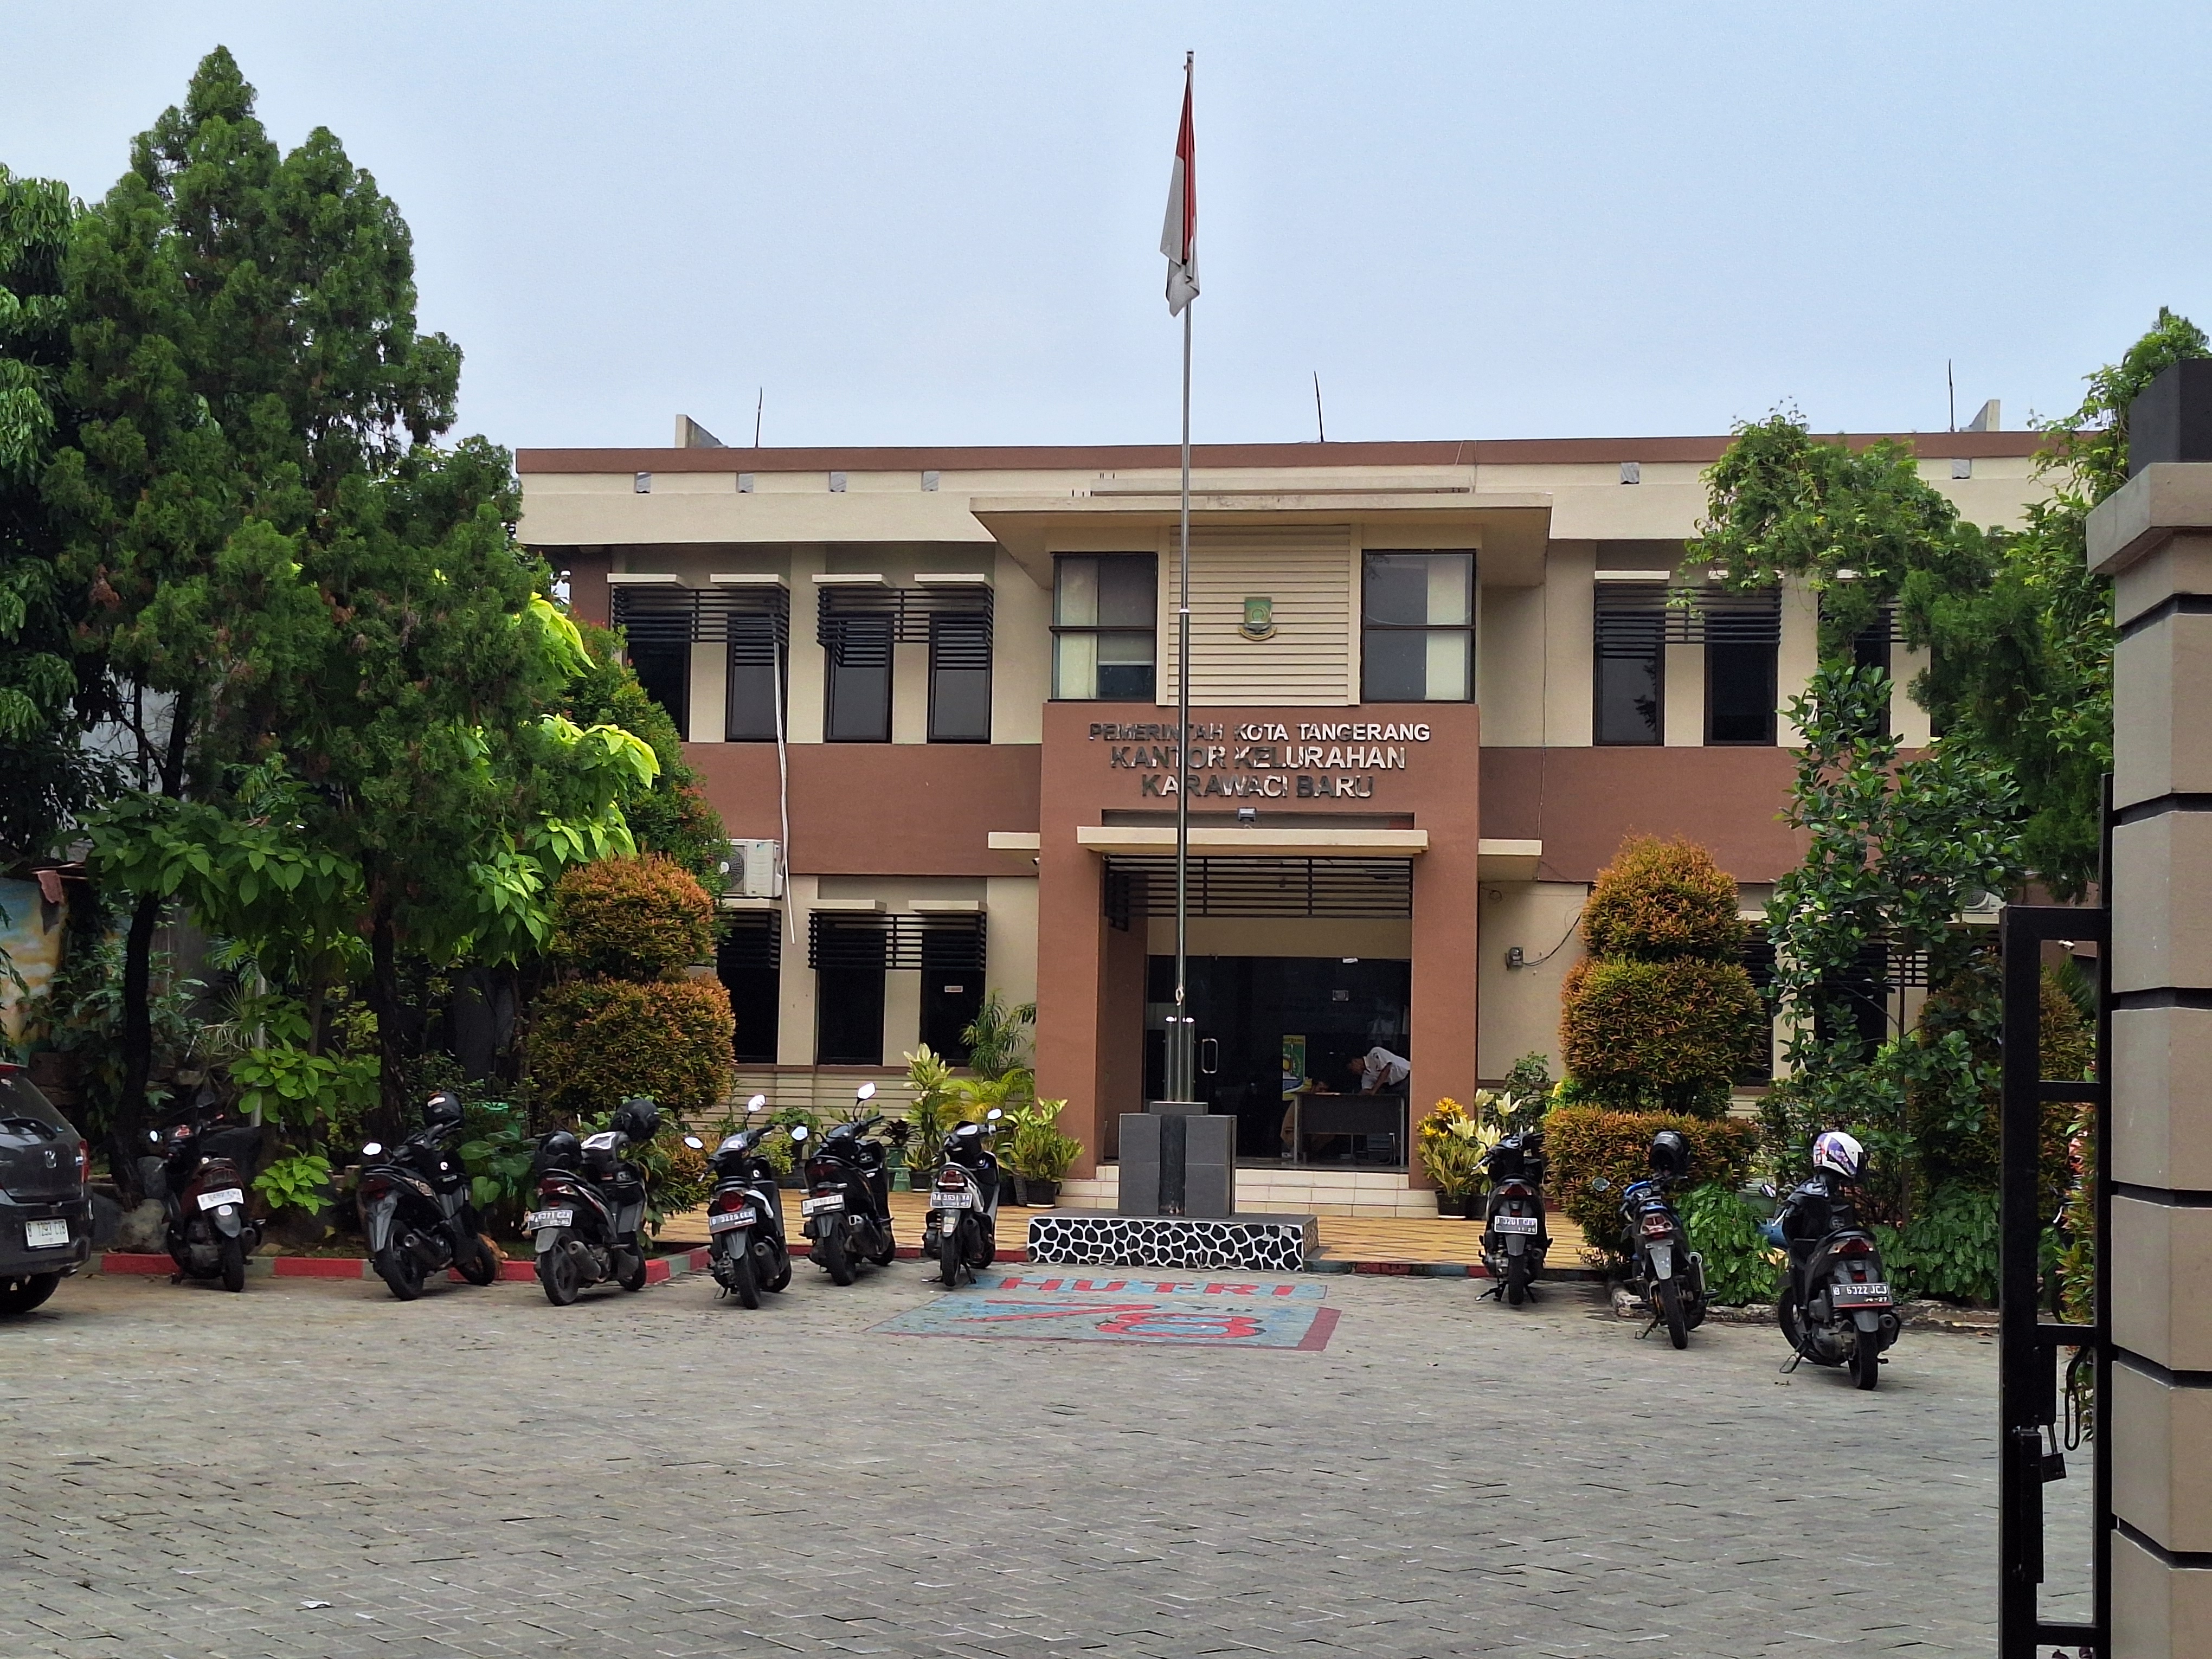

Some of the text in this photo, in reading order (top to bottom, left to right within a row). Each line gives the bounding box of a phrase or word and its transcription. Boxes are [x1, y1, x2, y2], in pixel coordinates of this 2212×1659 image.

[1234, 723, 1289, 741] KOTA
[1296, 723, 1430, 741] TANGERANG
[1234, 746, 1405, 769] KELURAHAN
[1141, 774, 1374, 798] KARAWACI BARU
